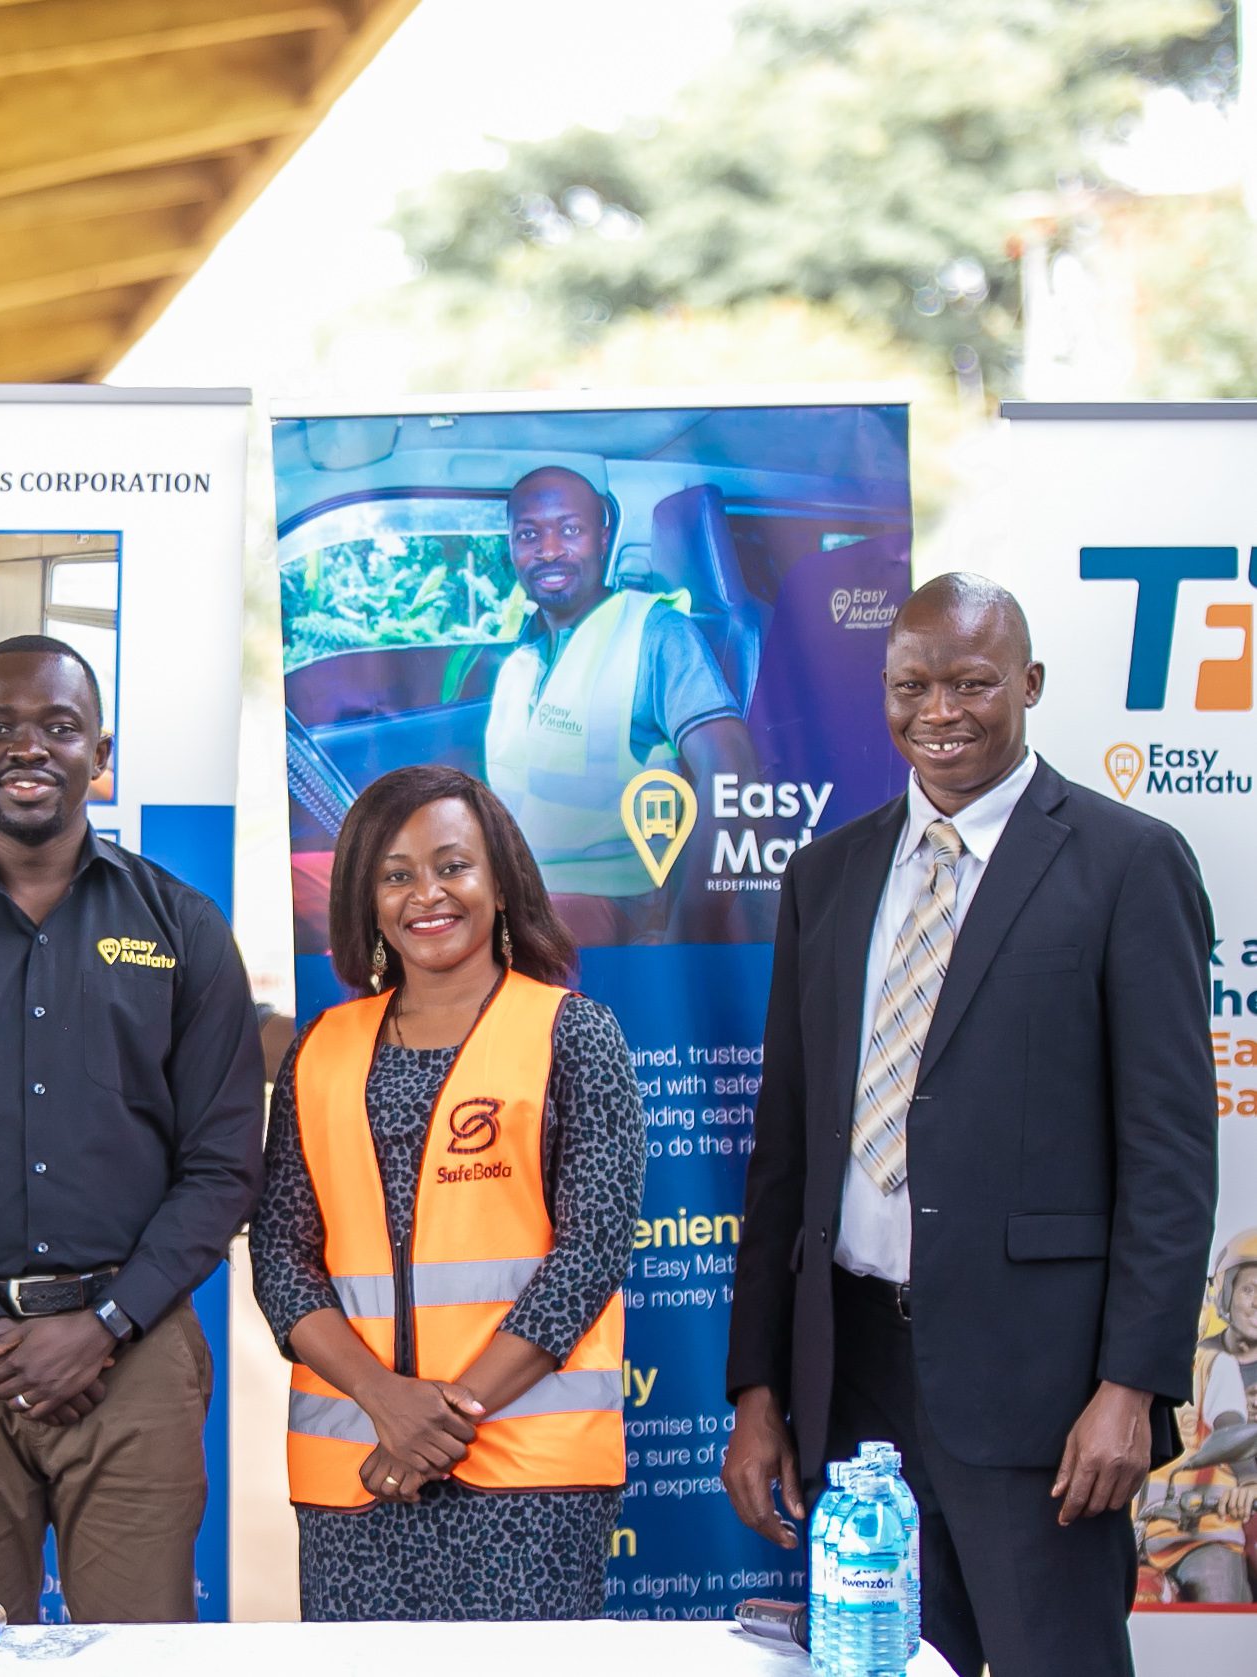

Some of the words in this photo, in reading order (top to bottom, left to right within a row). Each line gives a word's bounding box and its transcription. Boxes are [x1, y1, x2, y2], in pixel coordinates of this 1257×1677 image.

[20, 471, 211, 494] CORPORATION
[853, 588, 888, 606] Easy
[1149, 743, 1219, 773] Easy
[1146, 770, 1253, 795] Matatu
[713, 773, 834, 828] Easy
[706, 879, 782, 892] REDEFINING
[120, 937, 158, 956] Easy
[120, 949, 176, 969] Matatu
[688, 1043, 764, 1066] trusted
[667, 1074, 707, 1096] with
[702, 1102, 754, 1125] each
[668, 1135, 693, 1157] do
[698, 1134, 733, 1156] the
[436, 1161, 512, 1184] SafeBoda
[644, 1256, 691, 1281] Easy
[695, 1253, 737, 1275] Mat
[651, 1286, 717, 1310] money
[698, 1413, 718, 1434] to
[645, 1449, 691, 1468] sure
[696, 1442, 716, 1465] of
[631, 1572, 702, 1600] dignity
[706, 1570, 724, 1591] in
[729, 1567, 783, 1590] clean
[842, 1577, 894, 1589] Rwenzori
[656, 1603, 677, 1620] to
[871, 1600, 885, 1609] 500
